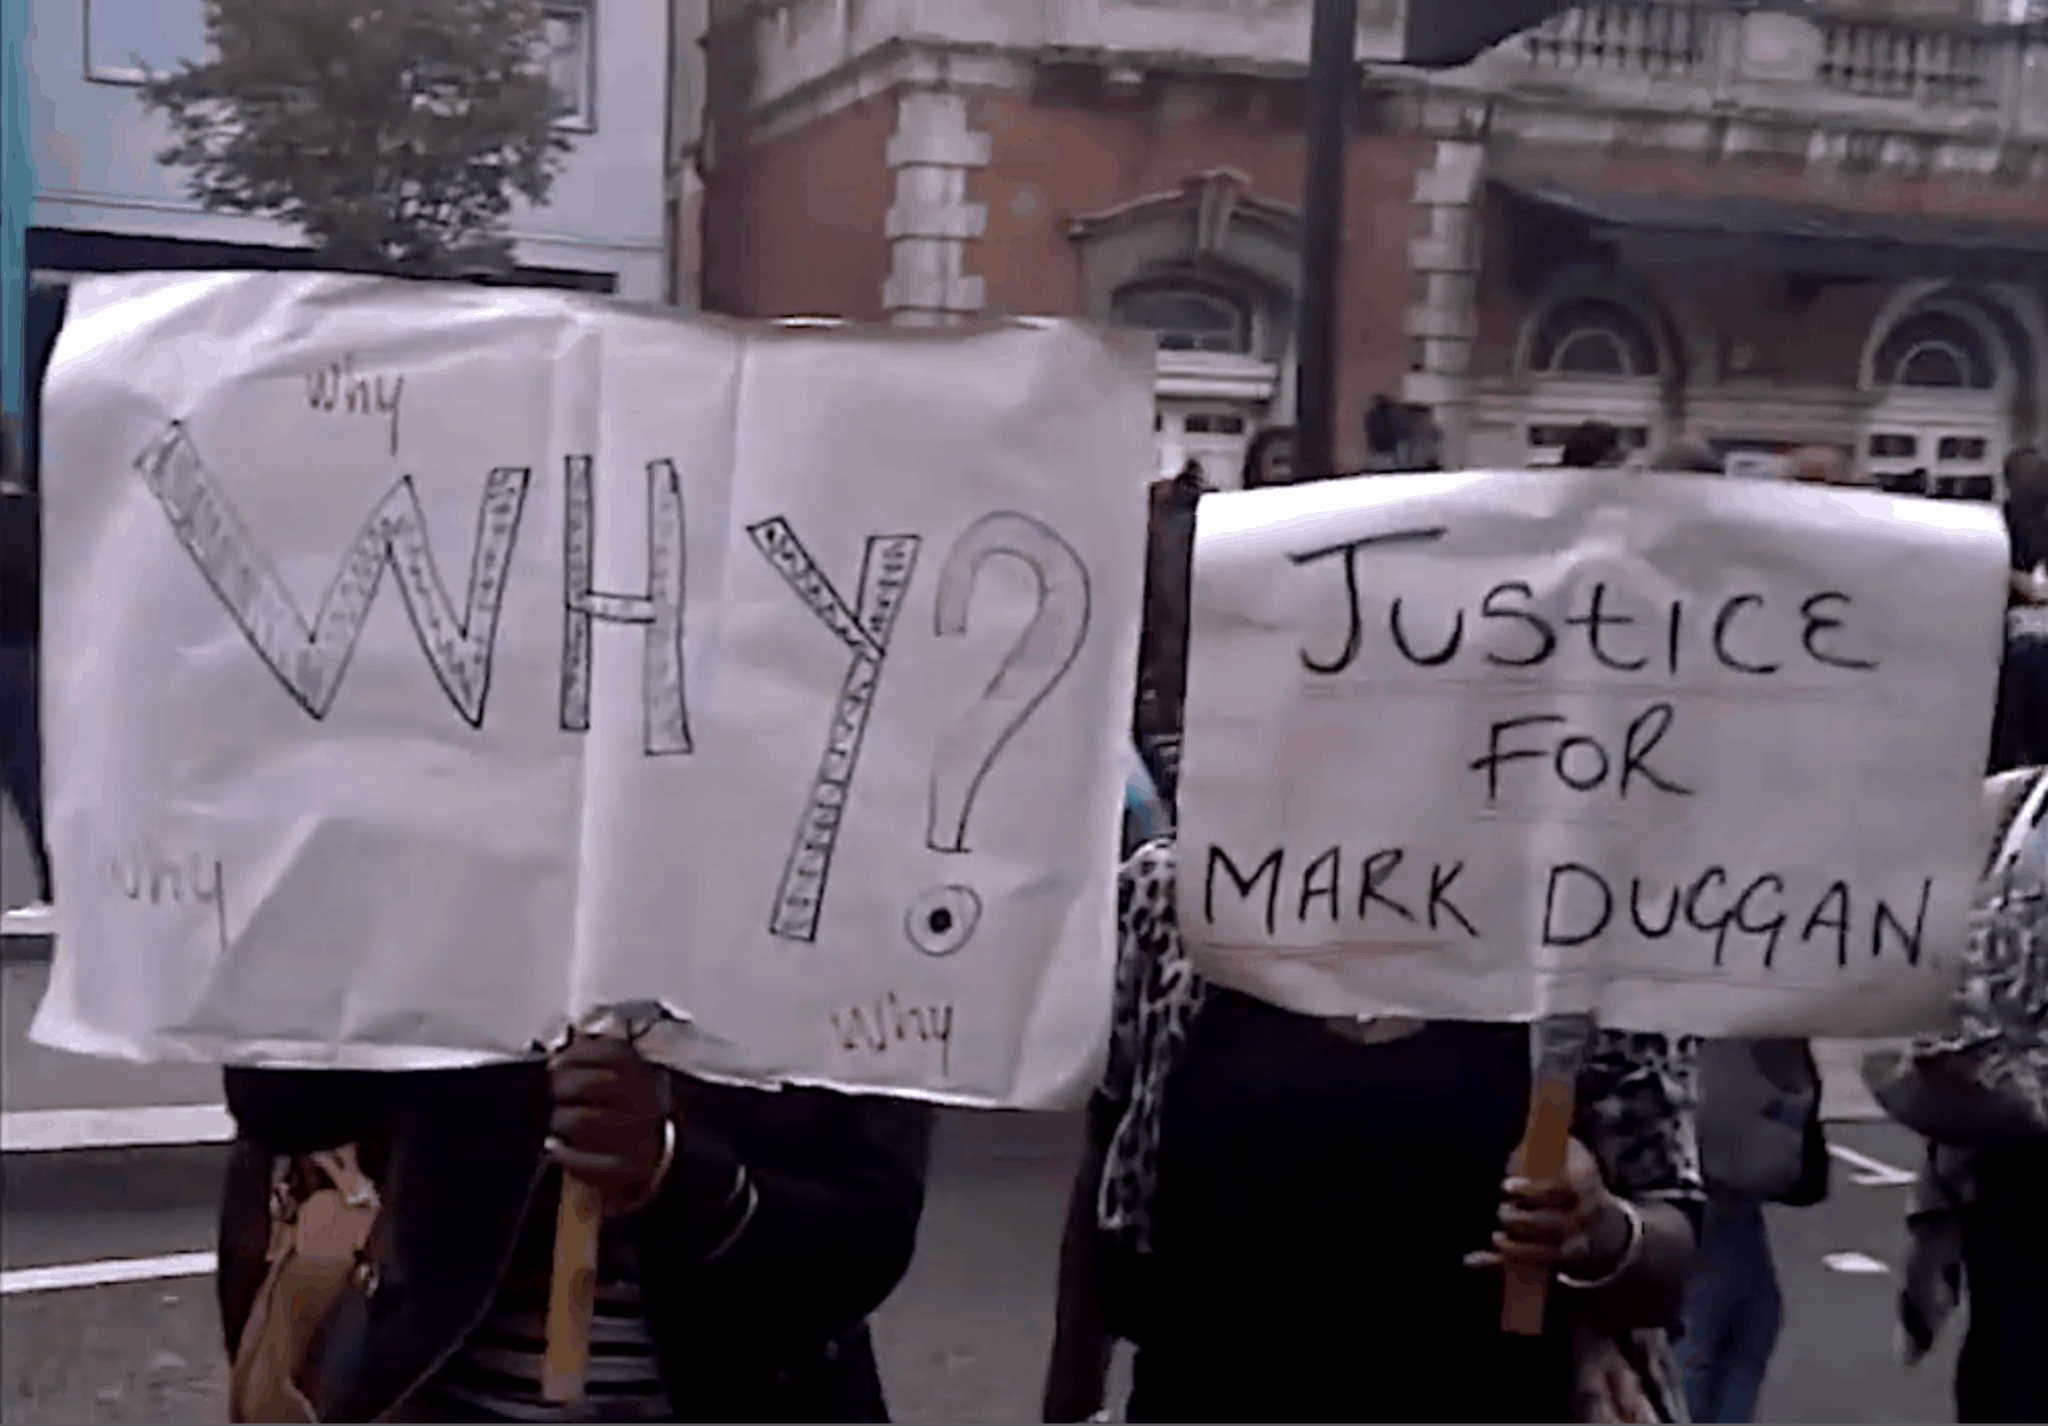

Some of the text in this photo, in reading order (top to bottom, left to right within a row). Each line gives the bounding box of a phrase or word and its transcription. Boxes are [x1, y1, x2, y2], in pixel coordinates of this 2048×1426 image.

[133, 417, 1092, 958] WHY?
[1468, 702, 1696, 799] FOR
[1203, 843, 1934, 970] MARK DUGGAN
